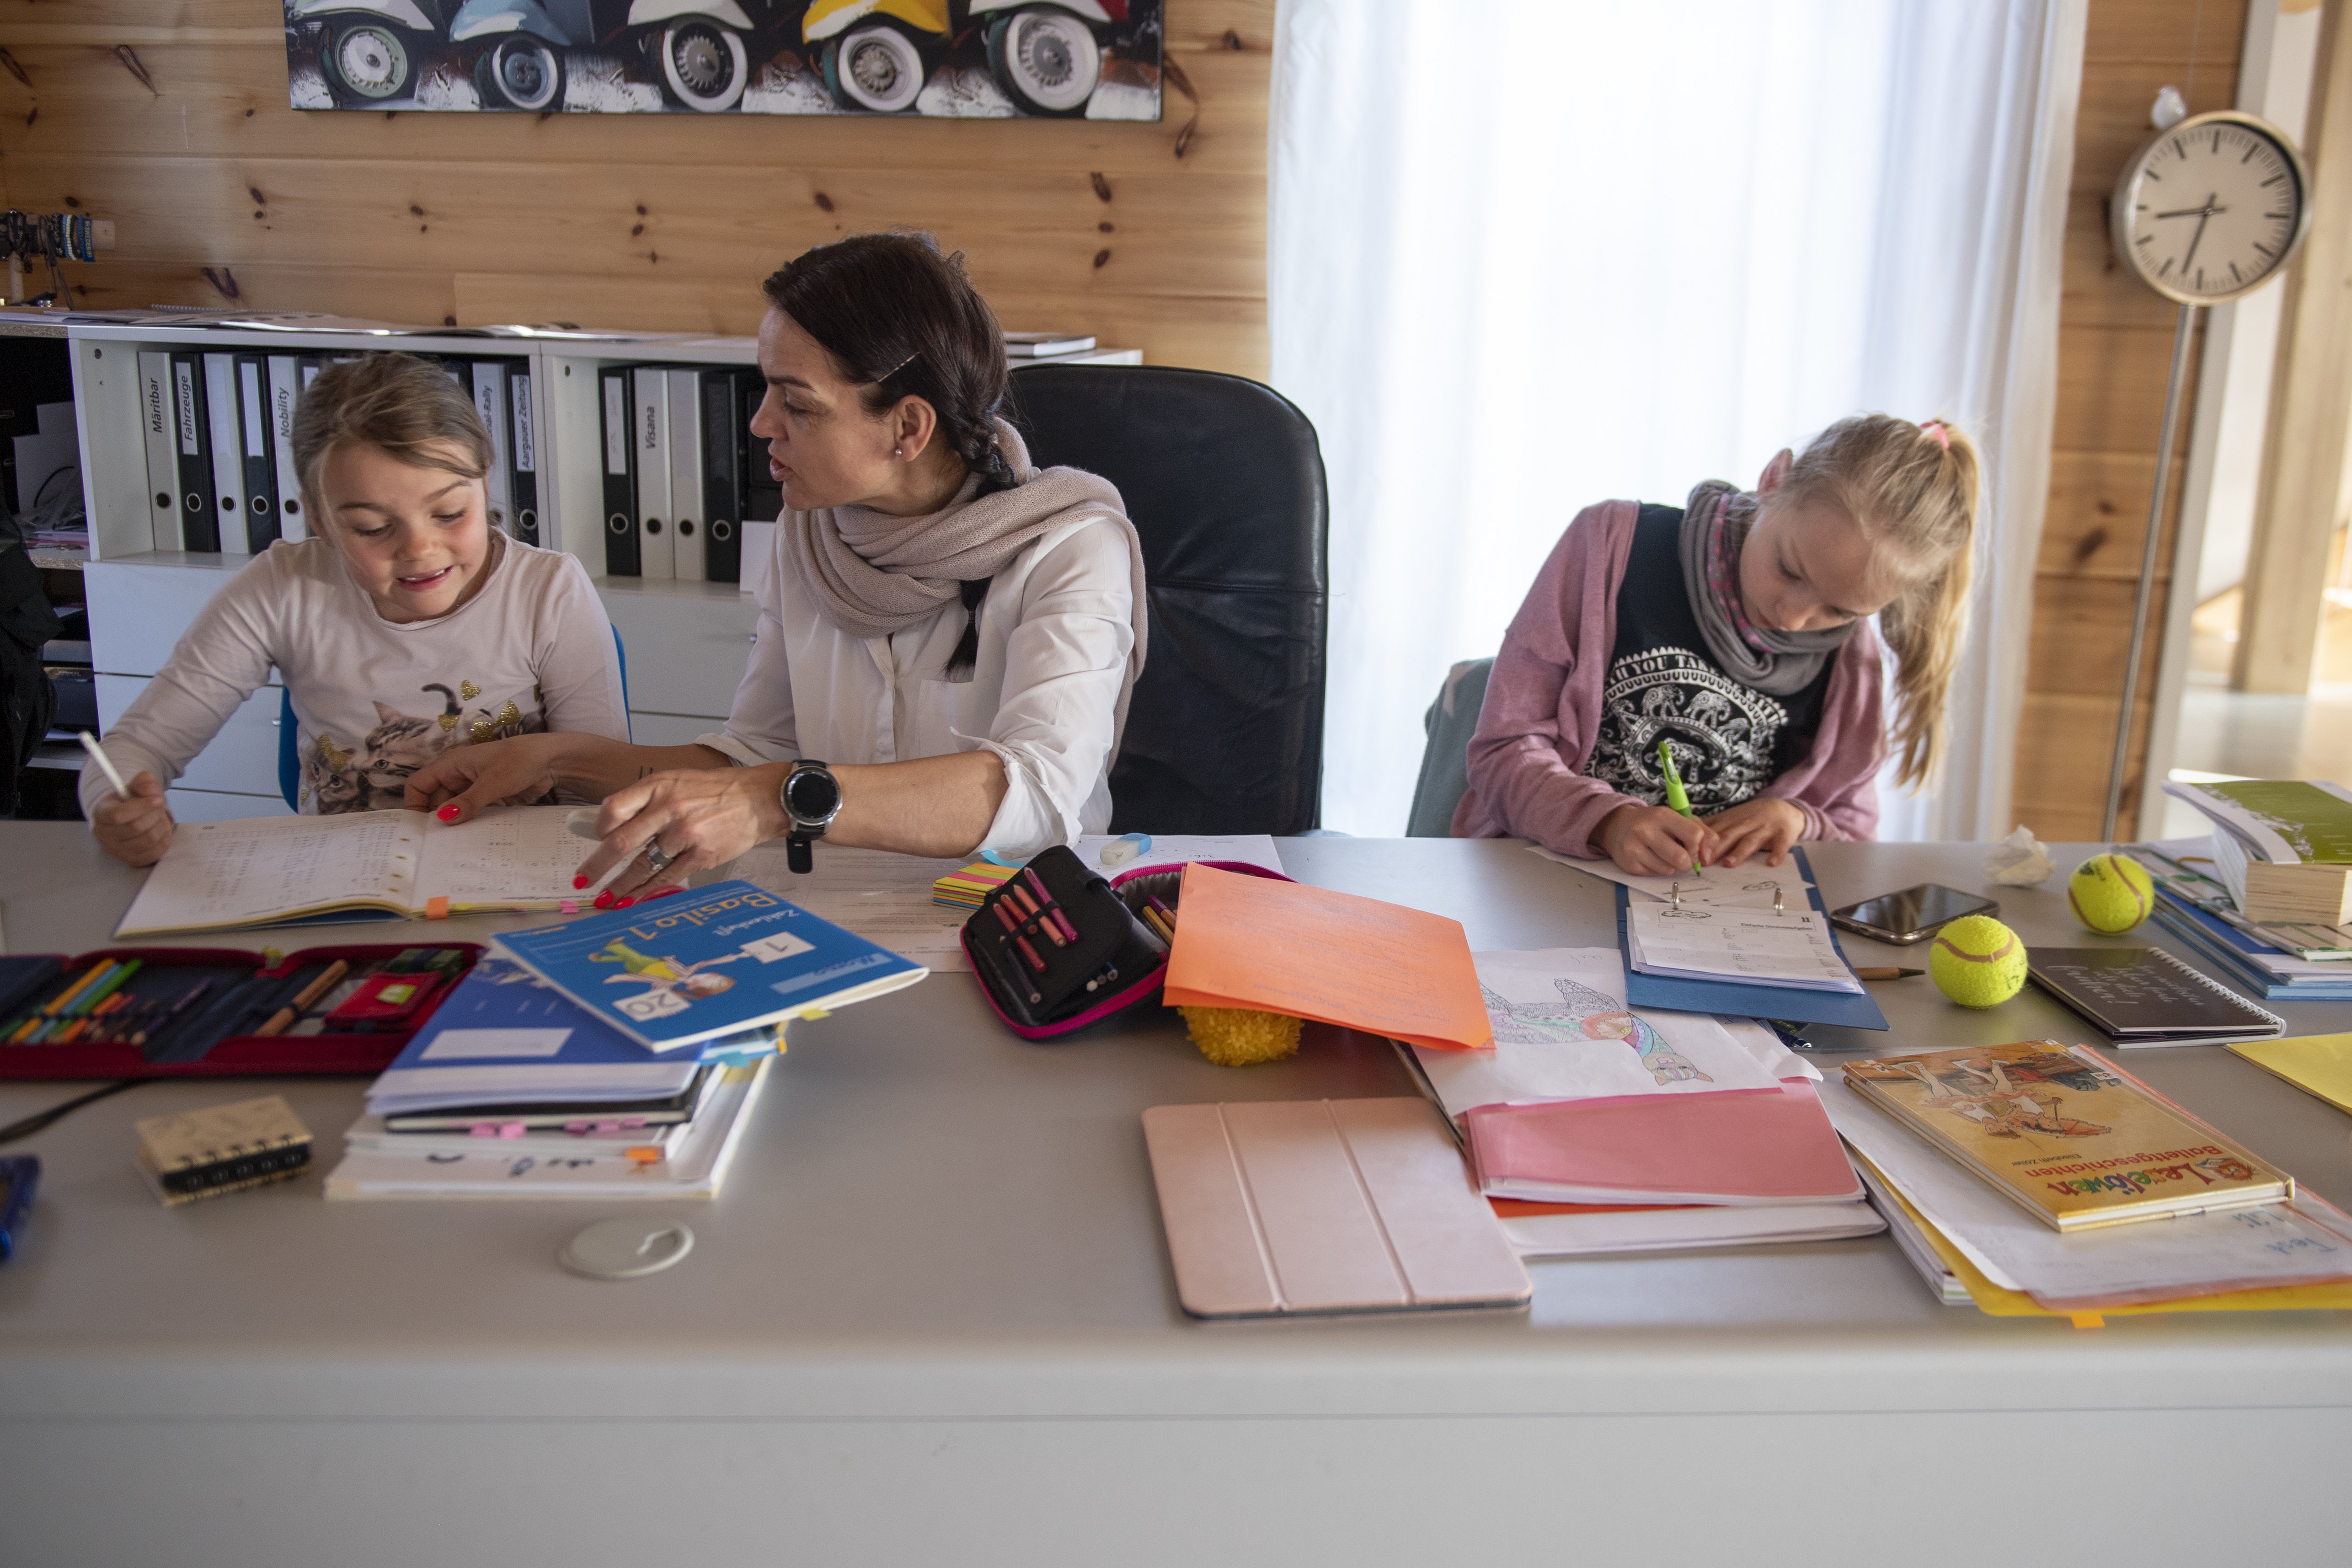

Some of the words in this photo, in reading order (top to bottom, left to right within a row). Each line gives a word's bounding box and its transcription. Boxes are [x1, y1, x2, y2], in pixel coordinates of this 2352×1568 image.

[149, 377, 163, 433] Märitbar
[181, 375, 193, 441] Fahrzeuge
[278, 386, 290, 438] Nobility
[518, 375, 527, 417] Zeitung
[521, 418, 531, 469] Aargauer
[645, 406, 656, 449] Visana
[1631, 655, 1668, 675] YOU
[626, 993, 679, 1016] 20
[2024, 1145, 2224, 1178] Ballettgeschichten
[2038, 1153, 2083, 1163] Elisabeth
[2046, 1162, 2217, 1197] Leselöwen
